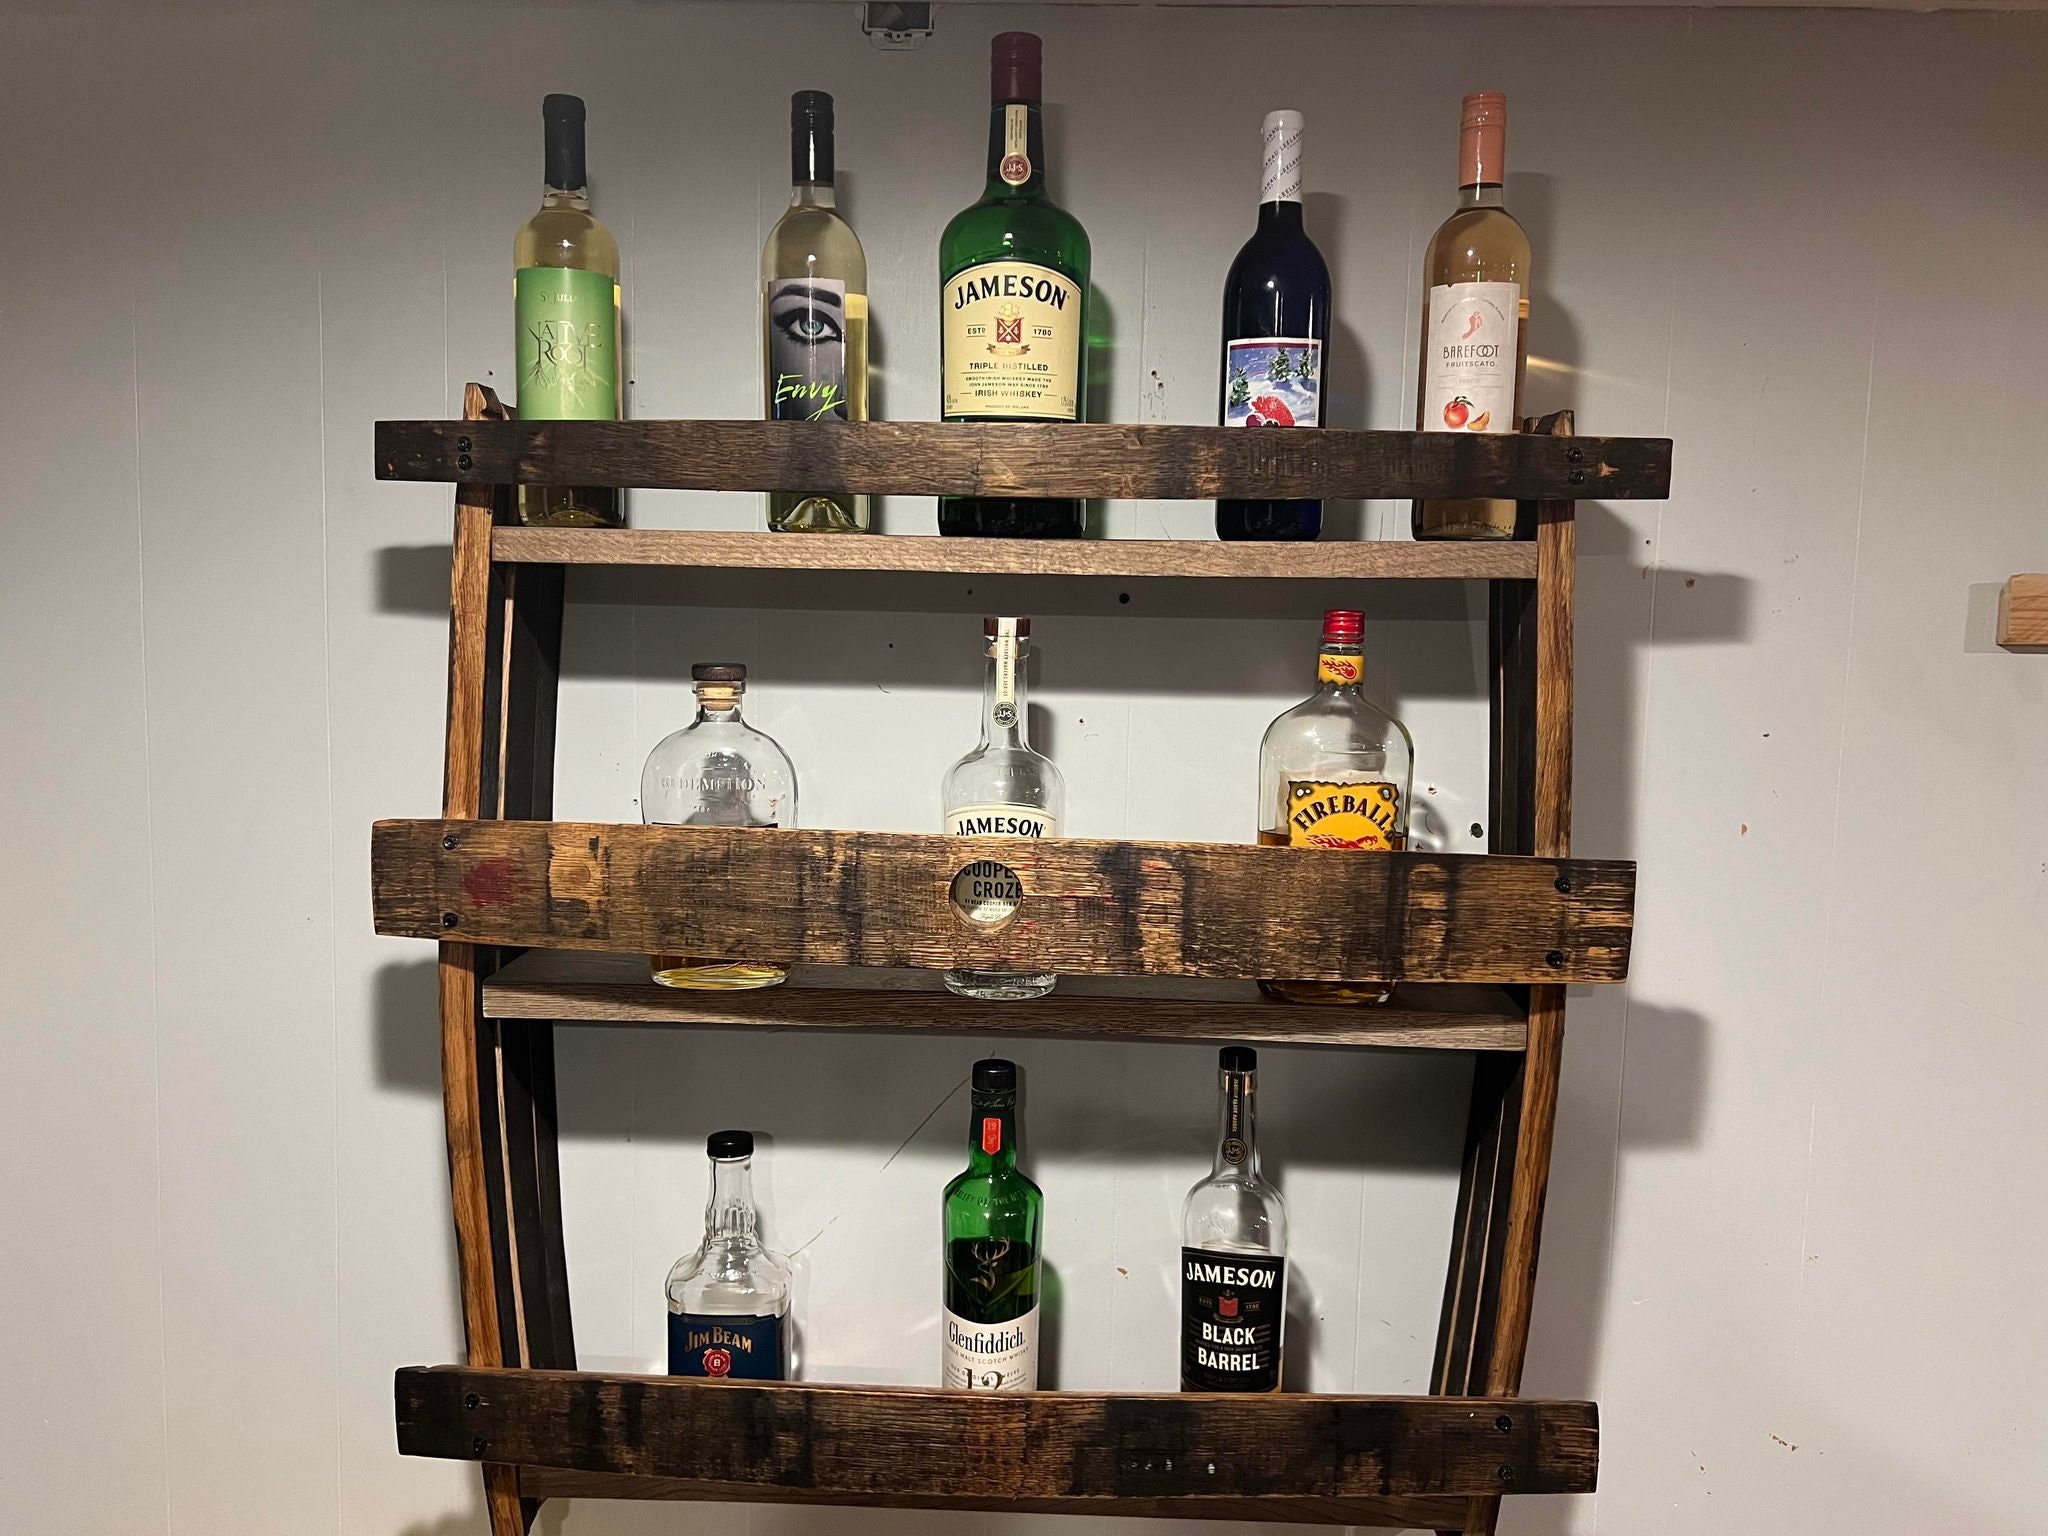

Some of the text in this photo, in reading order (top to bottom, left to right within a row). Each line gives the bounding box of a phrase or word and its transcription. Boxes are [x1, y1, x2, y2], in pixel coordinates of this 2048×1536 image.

[954, 274, 1068, 311] JAMESON
[1033, 328, 1052, 336] 1780
[1443, 344, 1499, 359] BAREFOOT
[969, 362, 1049, 371] TRIPLE DISTILLED
[1446, 360, 1496, 368] FRUITSCATO
[774, 373, 847, 422] Envy
[975, 389, 1043, 398] IRISH WHISKEY
[1292, 794, 1392, 832] FIREBALL
[956, 817, 1043, 838] JAMESON
[986, 1121, 998, 1131] 12
[1186, 1261, 1276, 1289] JAMESON
[684, 1325, 752, 1354] JIM BEAM
[949, 1320, 1023, 1354] Glenfiddich
[1202, 1321, 1256, 1346] BLACK
[960, 1353, 975, 1363] MALT
[978, 1357, 1007, 1365] SCOTCH
[1198, 1346, 1260, 1372] BARREL
